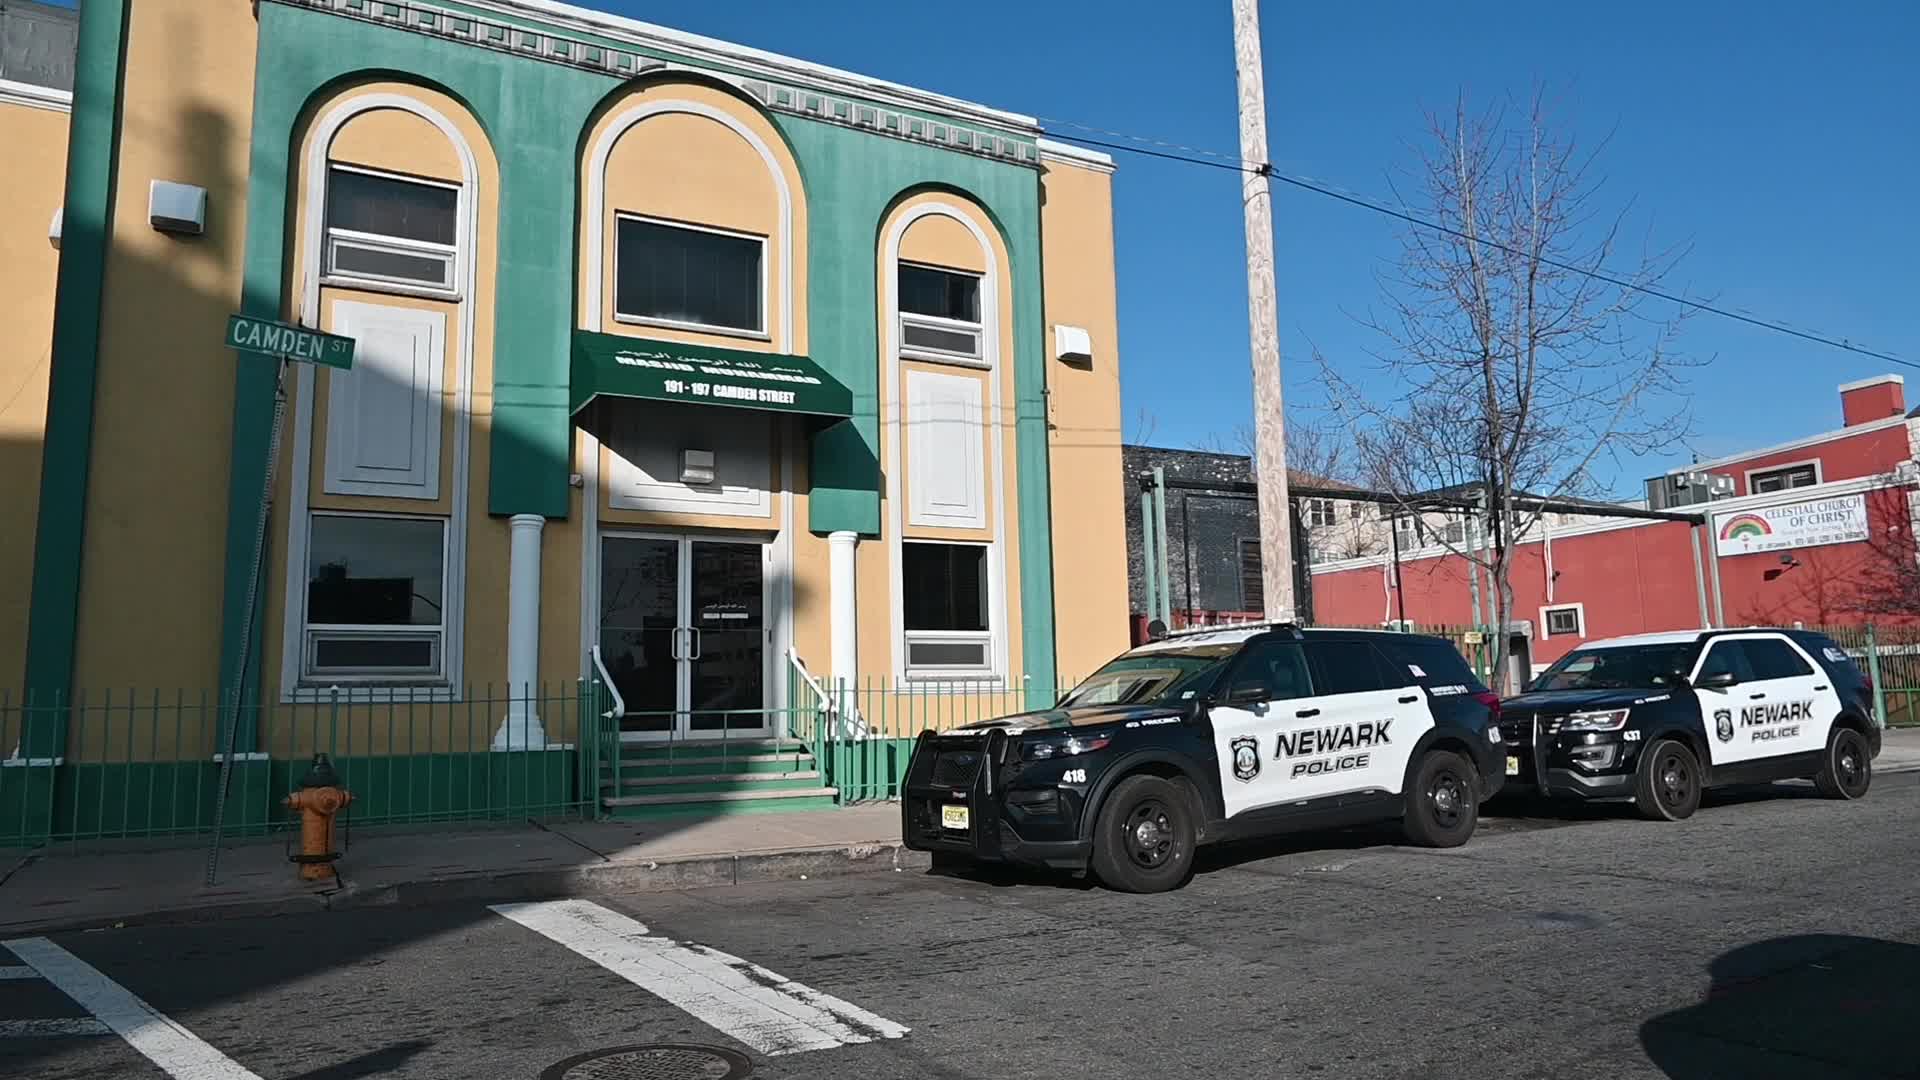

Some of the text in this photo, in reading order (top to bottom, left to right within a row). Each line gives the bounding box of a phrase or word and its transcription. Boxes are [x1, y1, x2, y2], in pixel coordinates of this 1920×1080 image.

[234, 320, 349, 359] CAMDEN ST
[664, 380, 684, 394] 191
[691, 382, 710, 396] 197
[713, 385, 757, 401] CAMDEN
[758, 390, 795, 404] STREET
[1765, 496, 1861, 519] CELESTIAL CHURCH
[1790, 510, 1852, 527] OF CHRIST
[1740, 700, 1814, 727] NEWARK
[1274, 719, 1394, 760] NEWARK
[1751, 727, 1800, 742] POLICE
[1062, 769, 1086, 783] 418
[1291, 752, 1370, 779] POLICE
